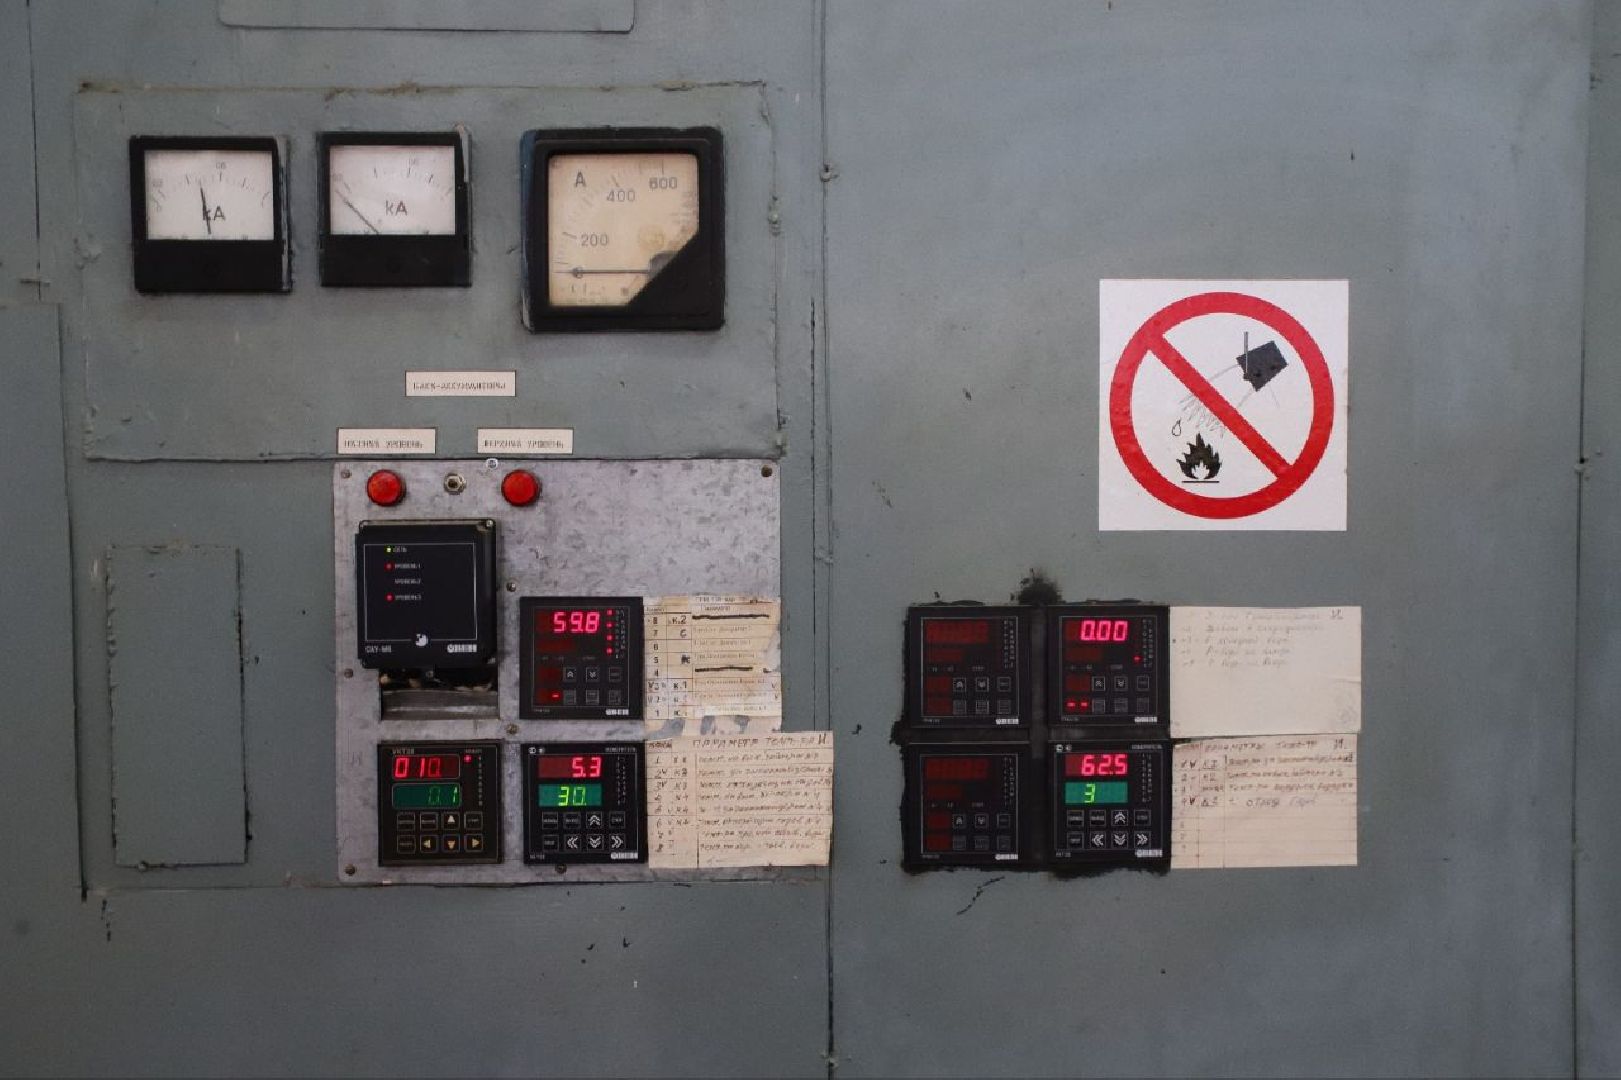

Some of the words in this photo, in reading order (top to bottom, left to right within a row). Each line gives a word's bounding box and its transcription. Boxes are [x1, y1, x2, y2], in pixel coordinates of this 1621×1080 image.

[573, 170, 587, 188] A
[648, 176, 678, 190] 600
[605, 189, 636, 203] 400
[385, 200, 408, 216] kA
[580, 233, 609, 247] 200
[553, 611, 601, 633] 59.8
[571, 757, 603, 778] 5.3
[1081, 754, 1128, 776] 62.5
[1084, 783, 1096, 803] 3
